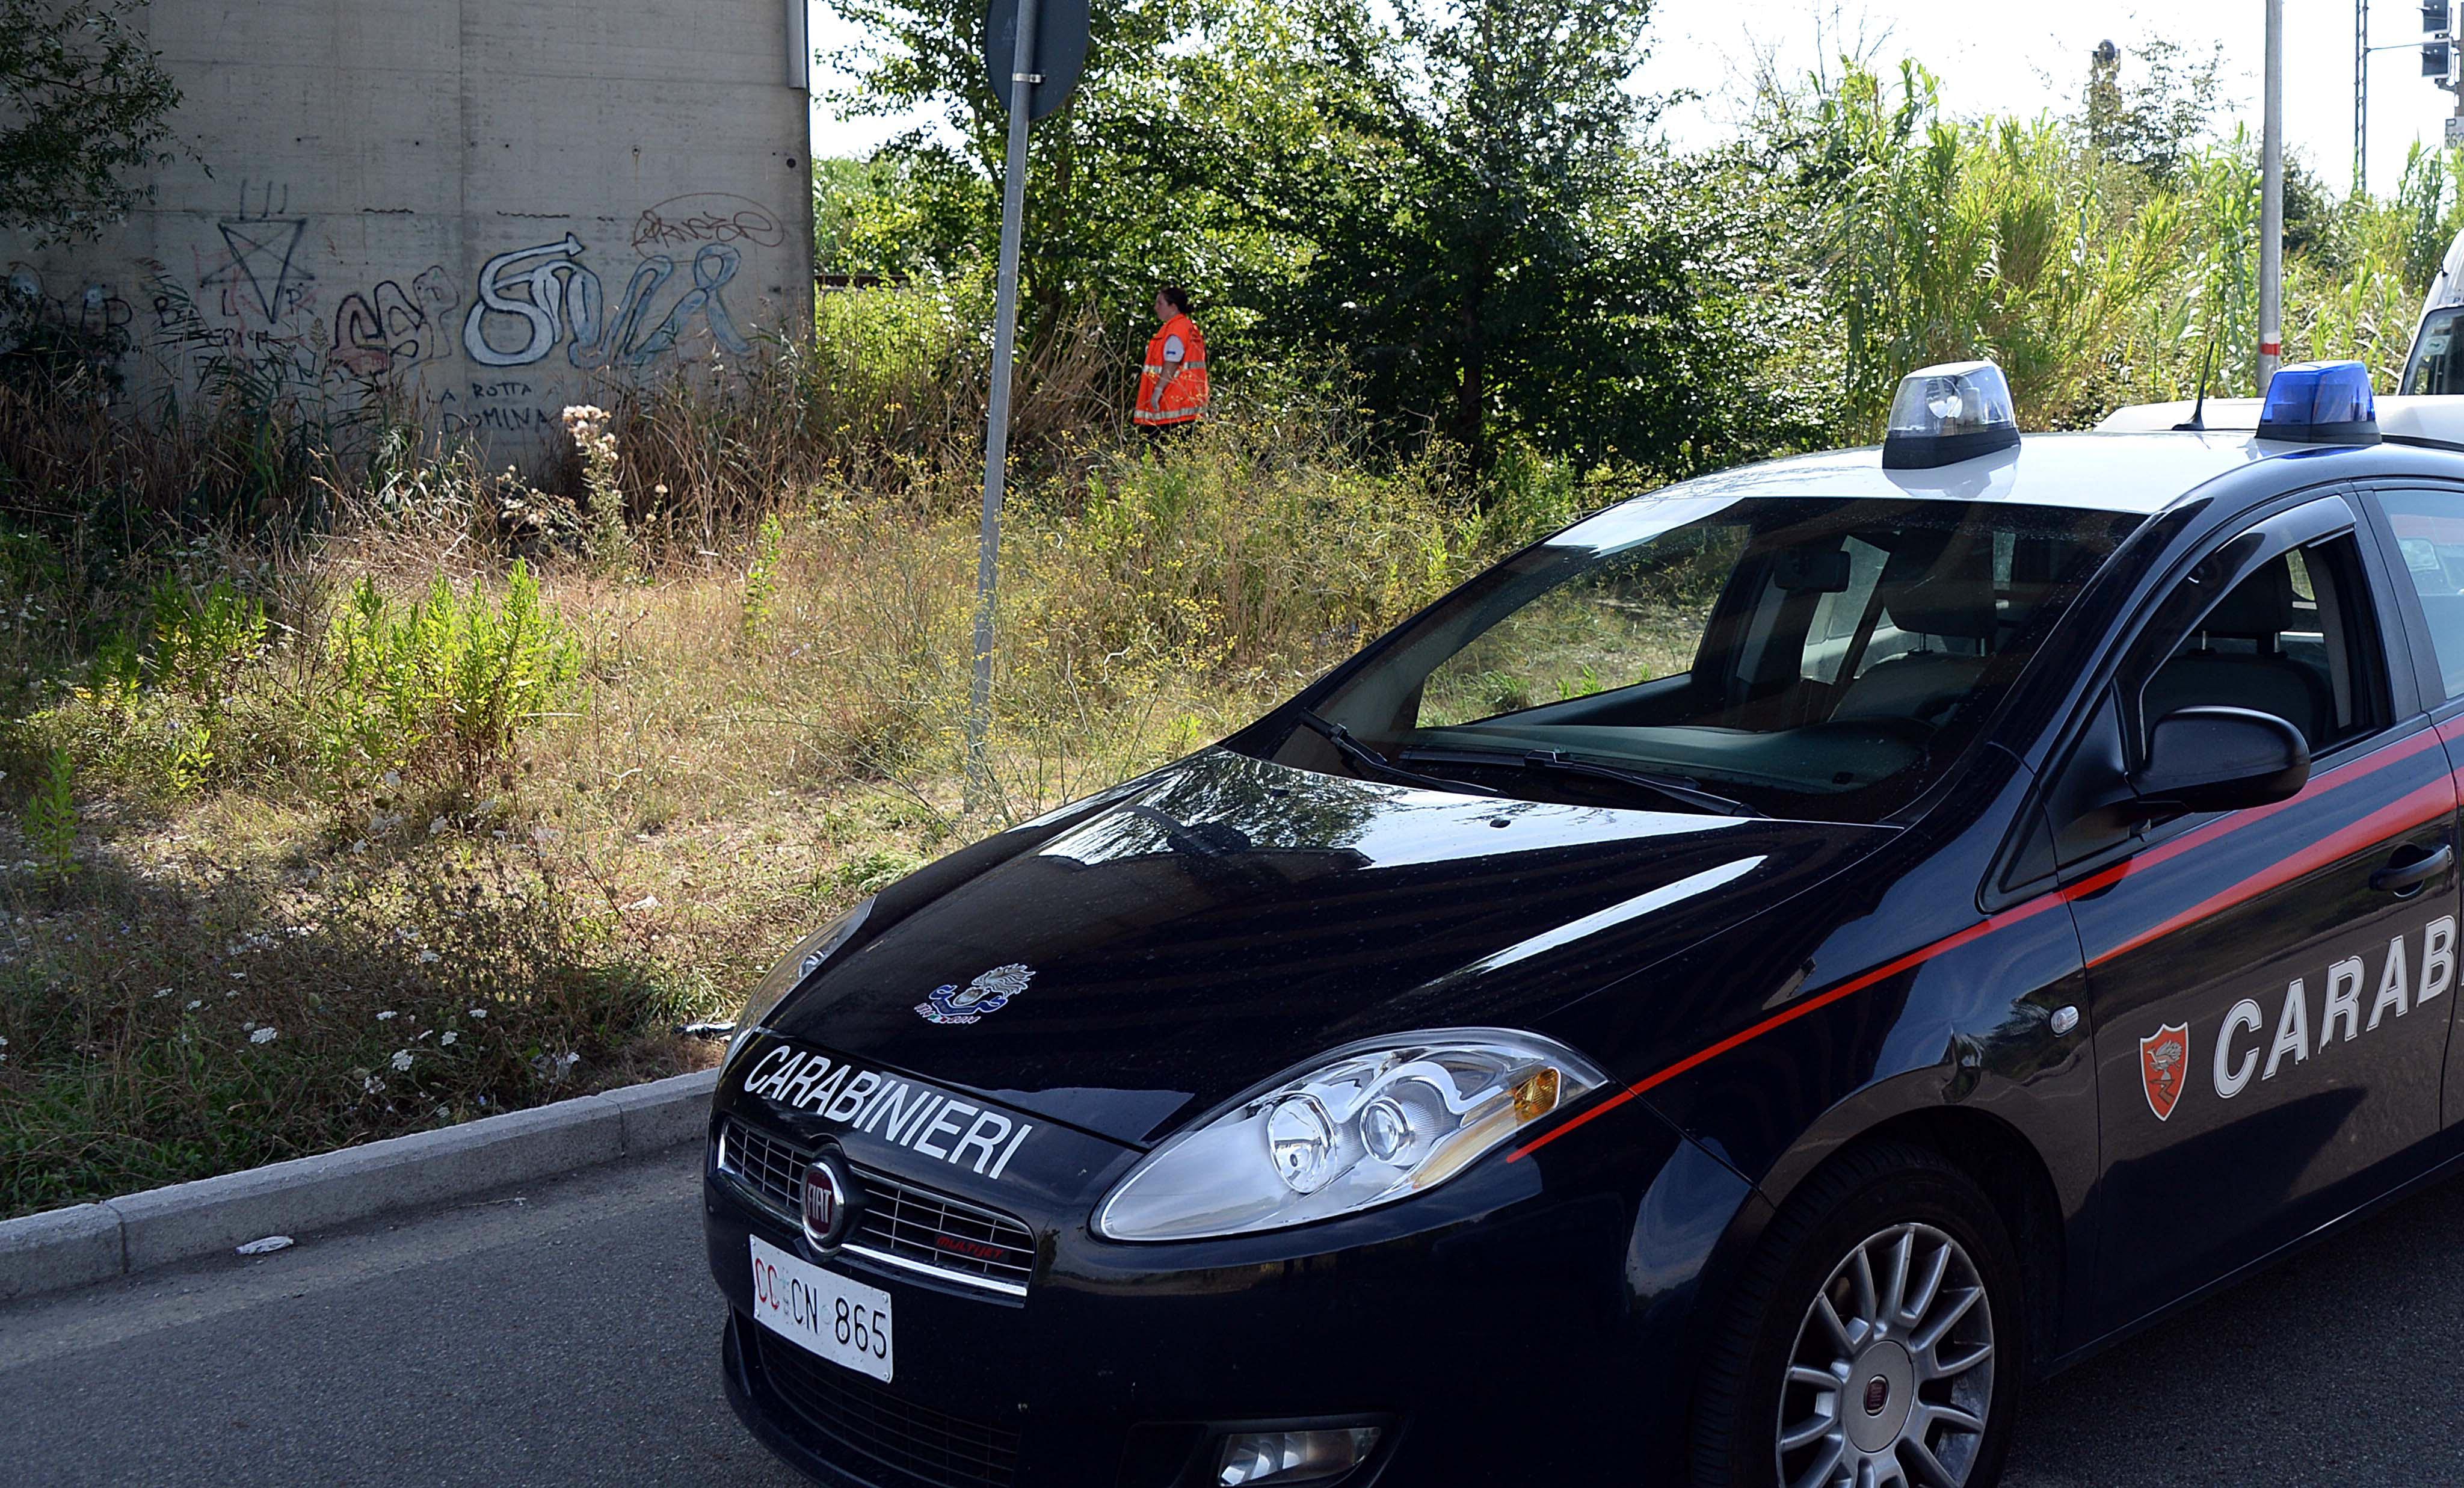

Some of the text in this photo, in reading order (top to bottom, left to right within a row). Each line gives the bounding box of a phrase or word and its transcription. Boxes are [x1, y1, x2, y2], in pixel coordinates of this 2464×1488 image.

[472, 382, 532, 399] ROTTA
[2213, 915, 2464, 1099] CARAB
[744, 1045, 1033, 1180] CARABINIERI
[808, 1182, 831, 1223] FIAT
[755, 1257, 888, 1359] CC CN 865
